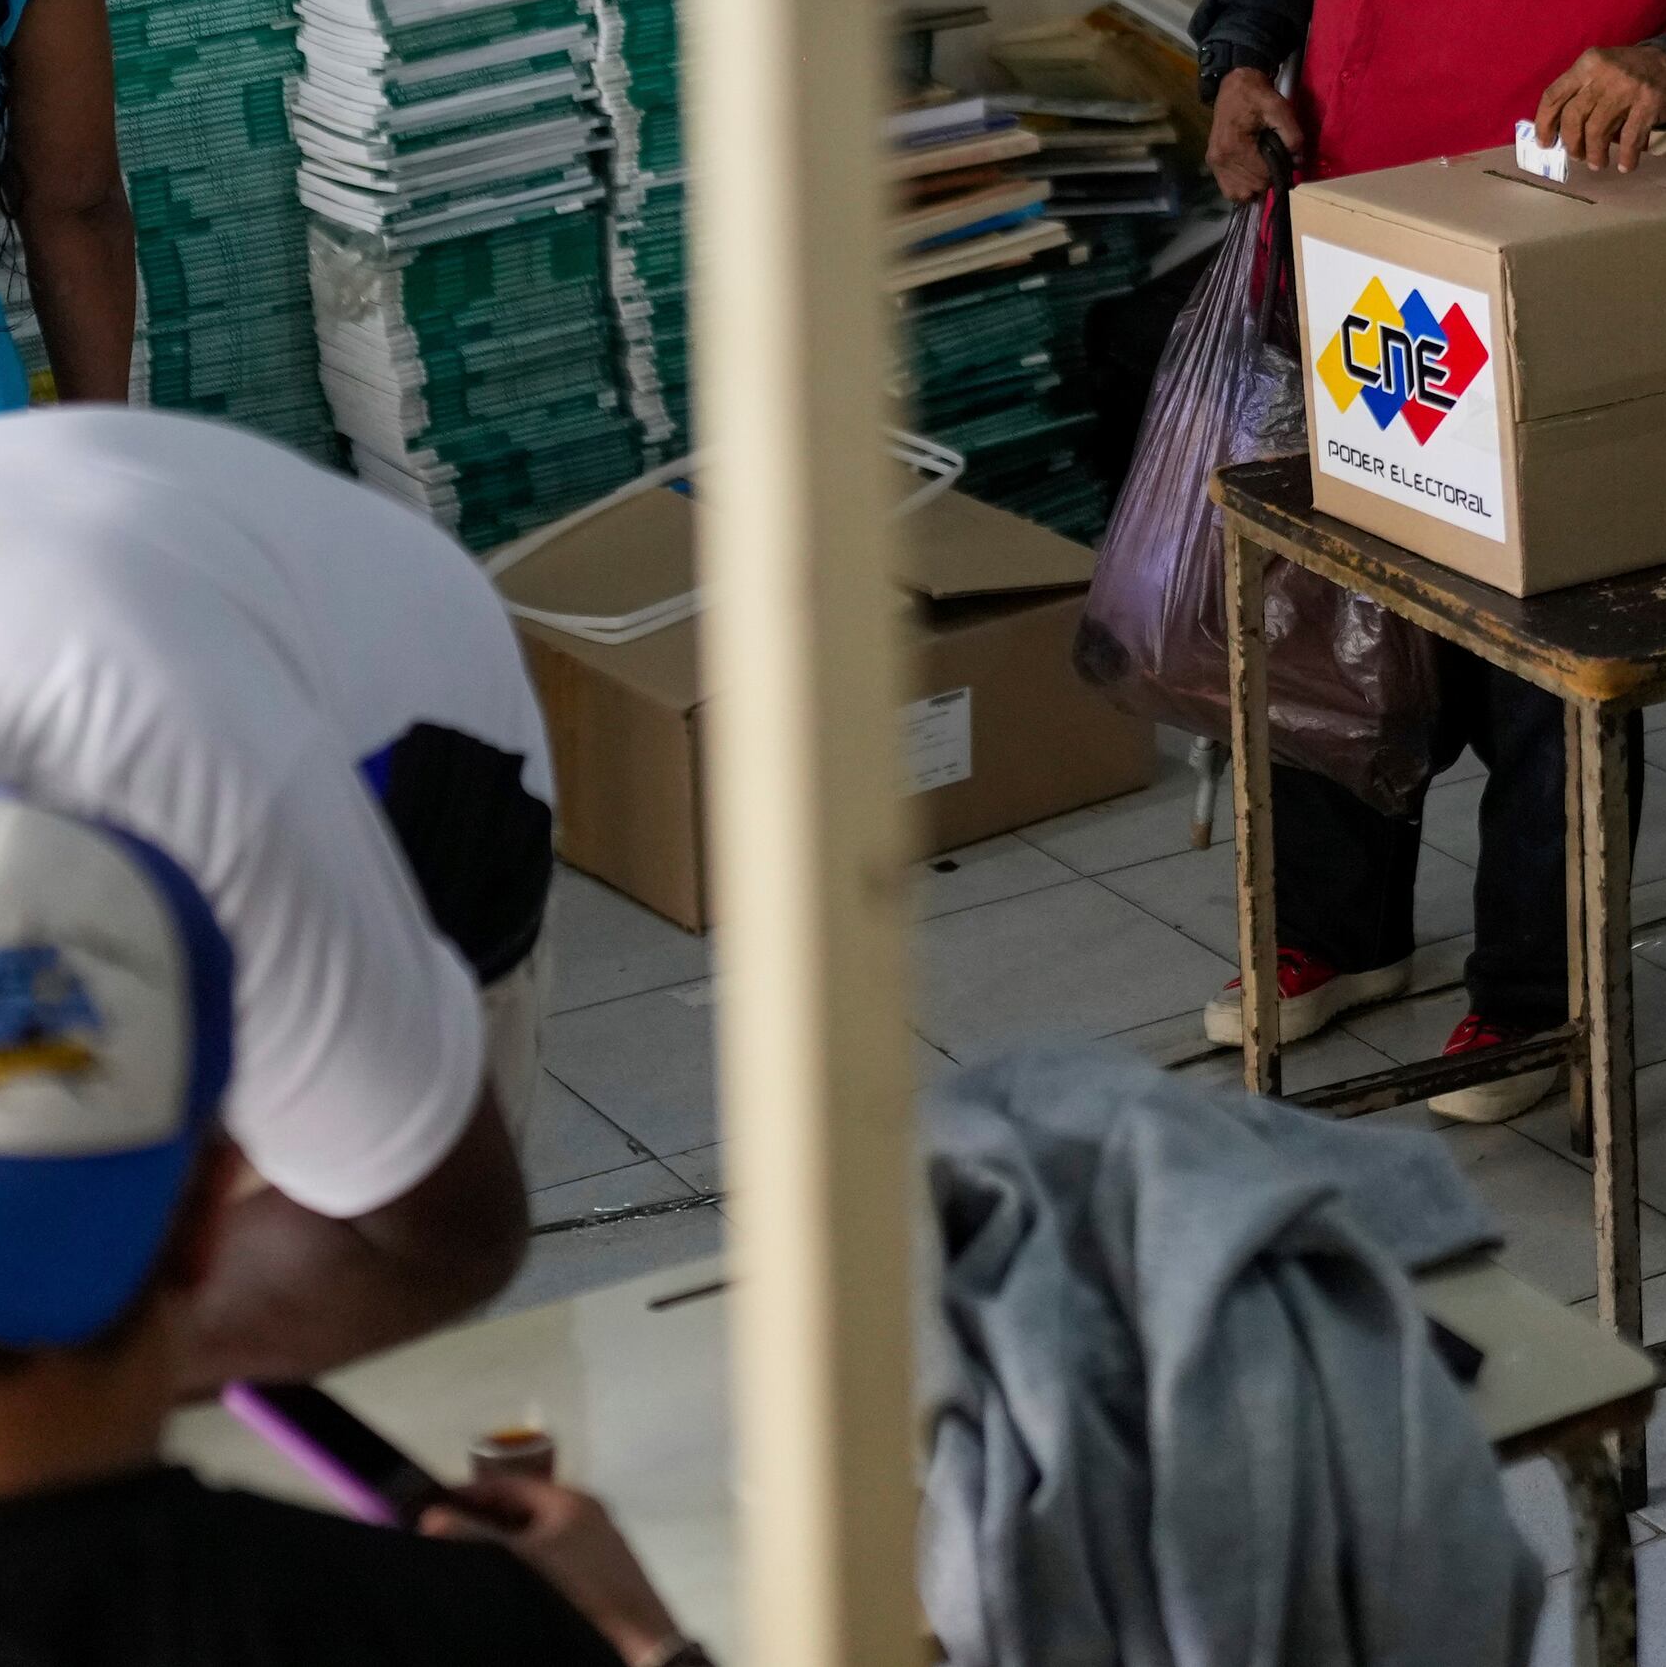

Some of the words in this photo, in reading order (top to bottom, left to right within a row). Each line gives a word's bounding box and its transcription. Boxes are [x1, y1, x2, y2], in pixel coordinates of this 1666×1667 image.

[1340, 313, 1458, 410] CNE
[1327, 439, 1385, 479] PODER
[1390, 463, 1493, 518] ELECTORAL
